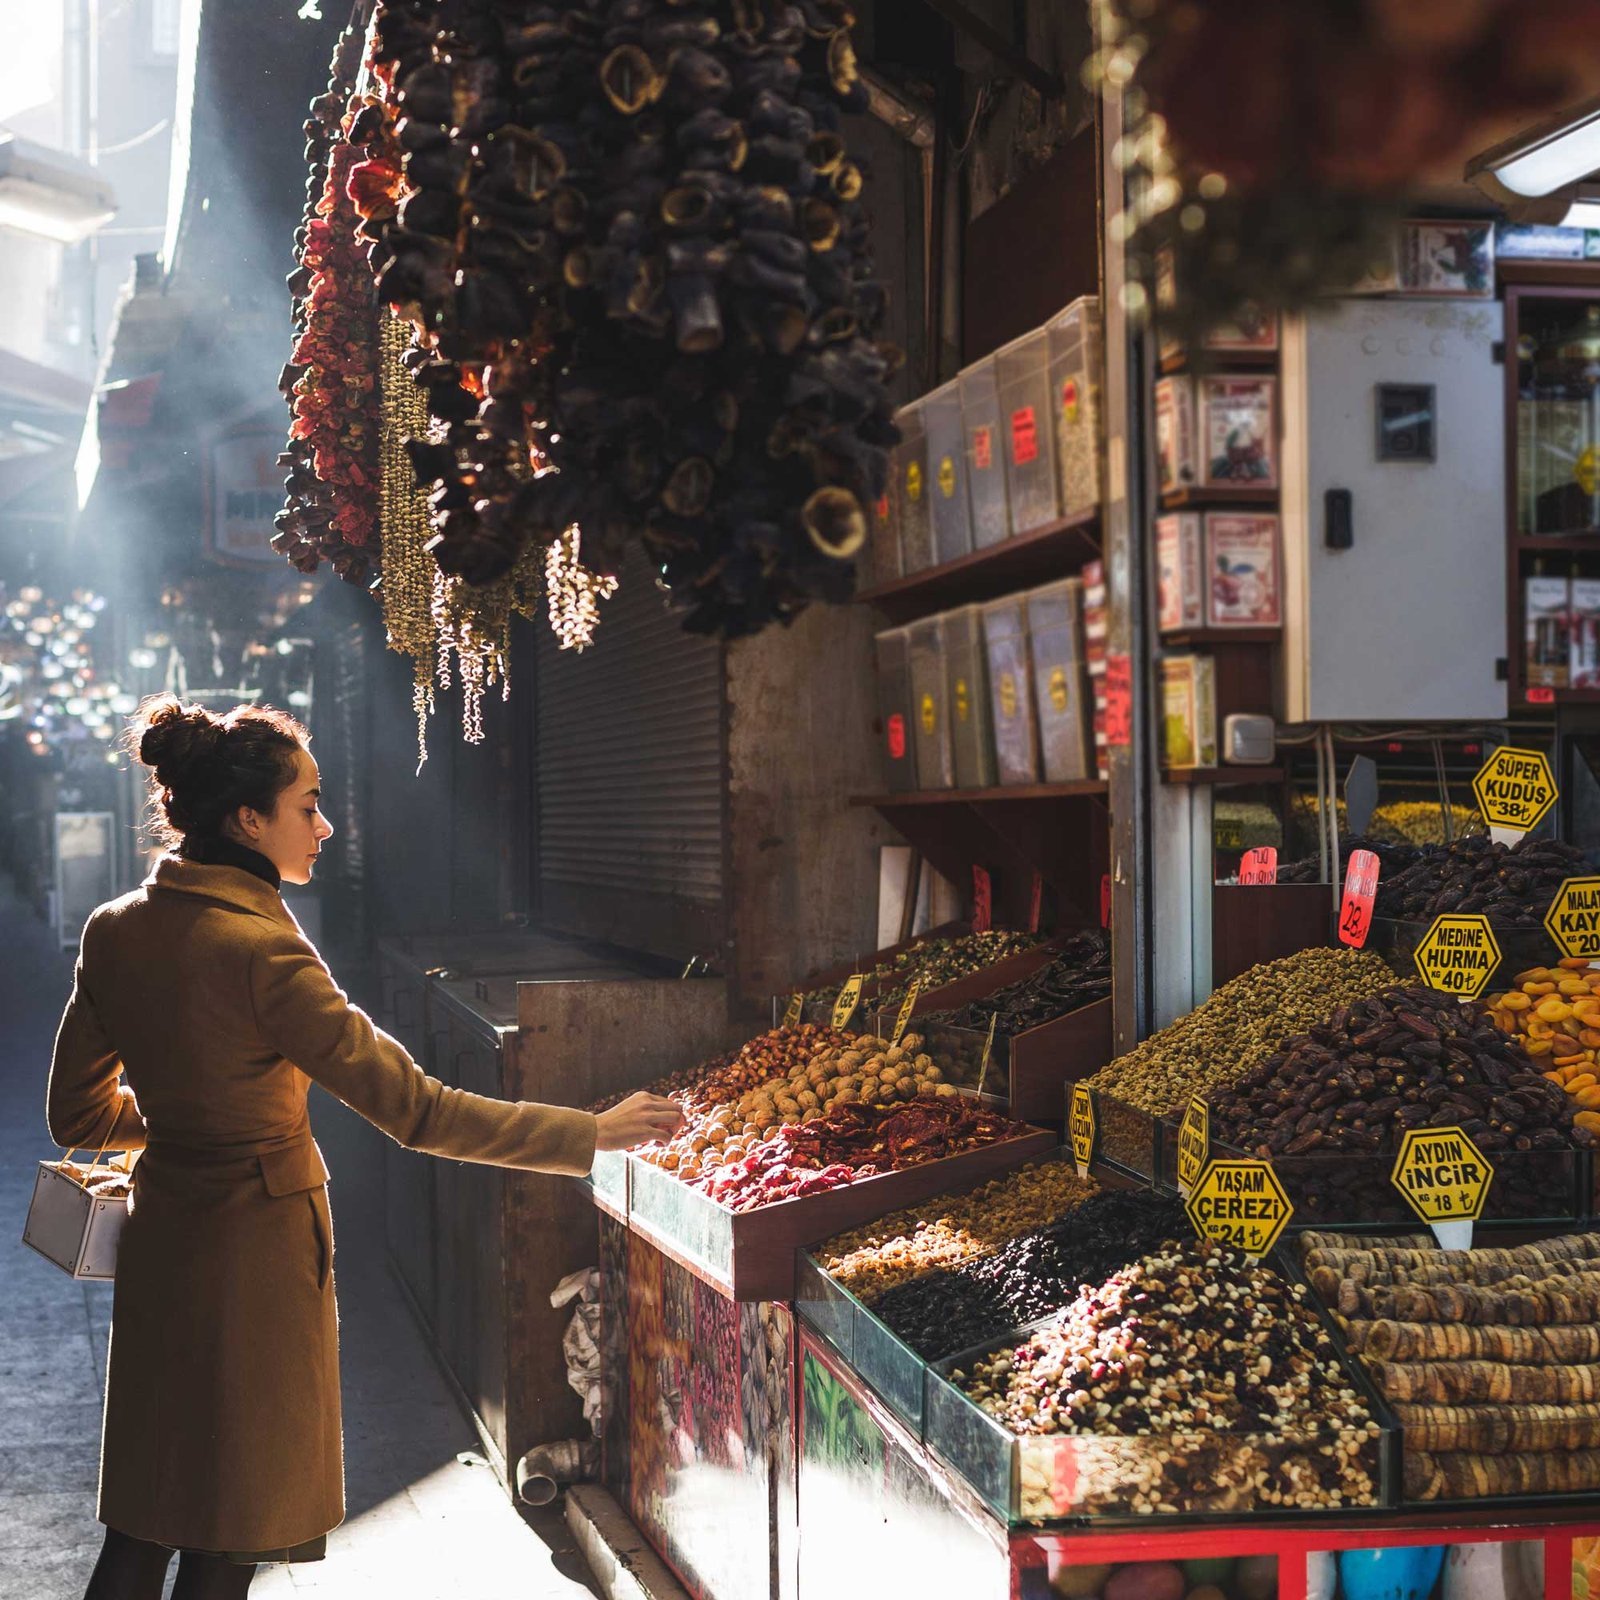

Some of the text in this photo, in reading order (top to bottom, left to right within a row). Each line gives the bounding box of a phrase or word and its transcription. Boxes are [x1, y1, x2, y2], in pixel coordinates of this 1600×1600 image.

[1497, 756, 1541, 781] SÜPER
[1485, 779, 1547, 804] KUDÜS
[1488, 799, 1498, 807] KG
[1566, 935, 1577, 943] KG
[1427, 949, 1489, 969] HURMA
[1431, 970, 1441, 978] KG
[1414, 1141, 1463, 1165] AYDIN
[1215, 1171, 1264, 1198] YAŞAM
[1418, 1193, 1430, 1203] KG
[1207, 1225, 1219, 1233] KG
